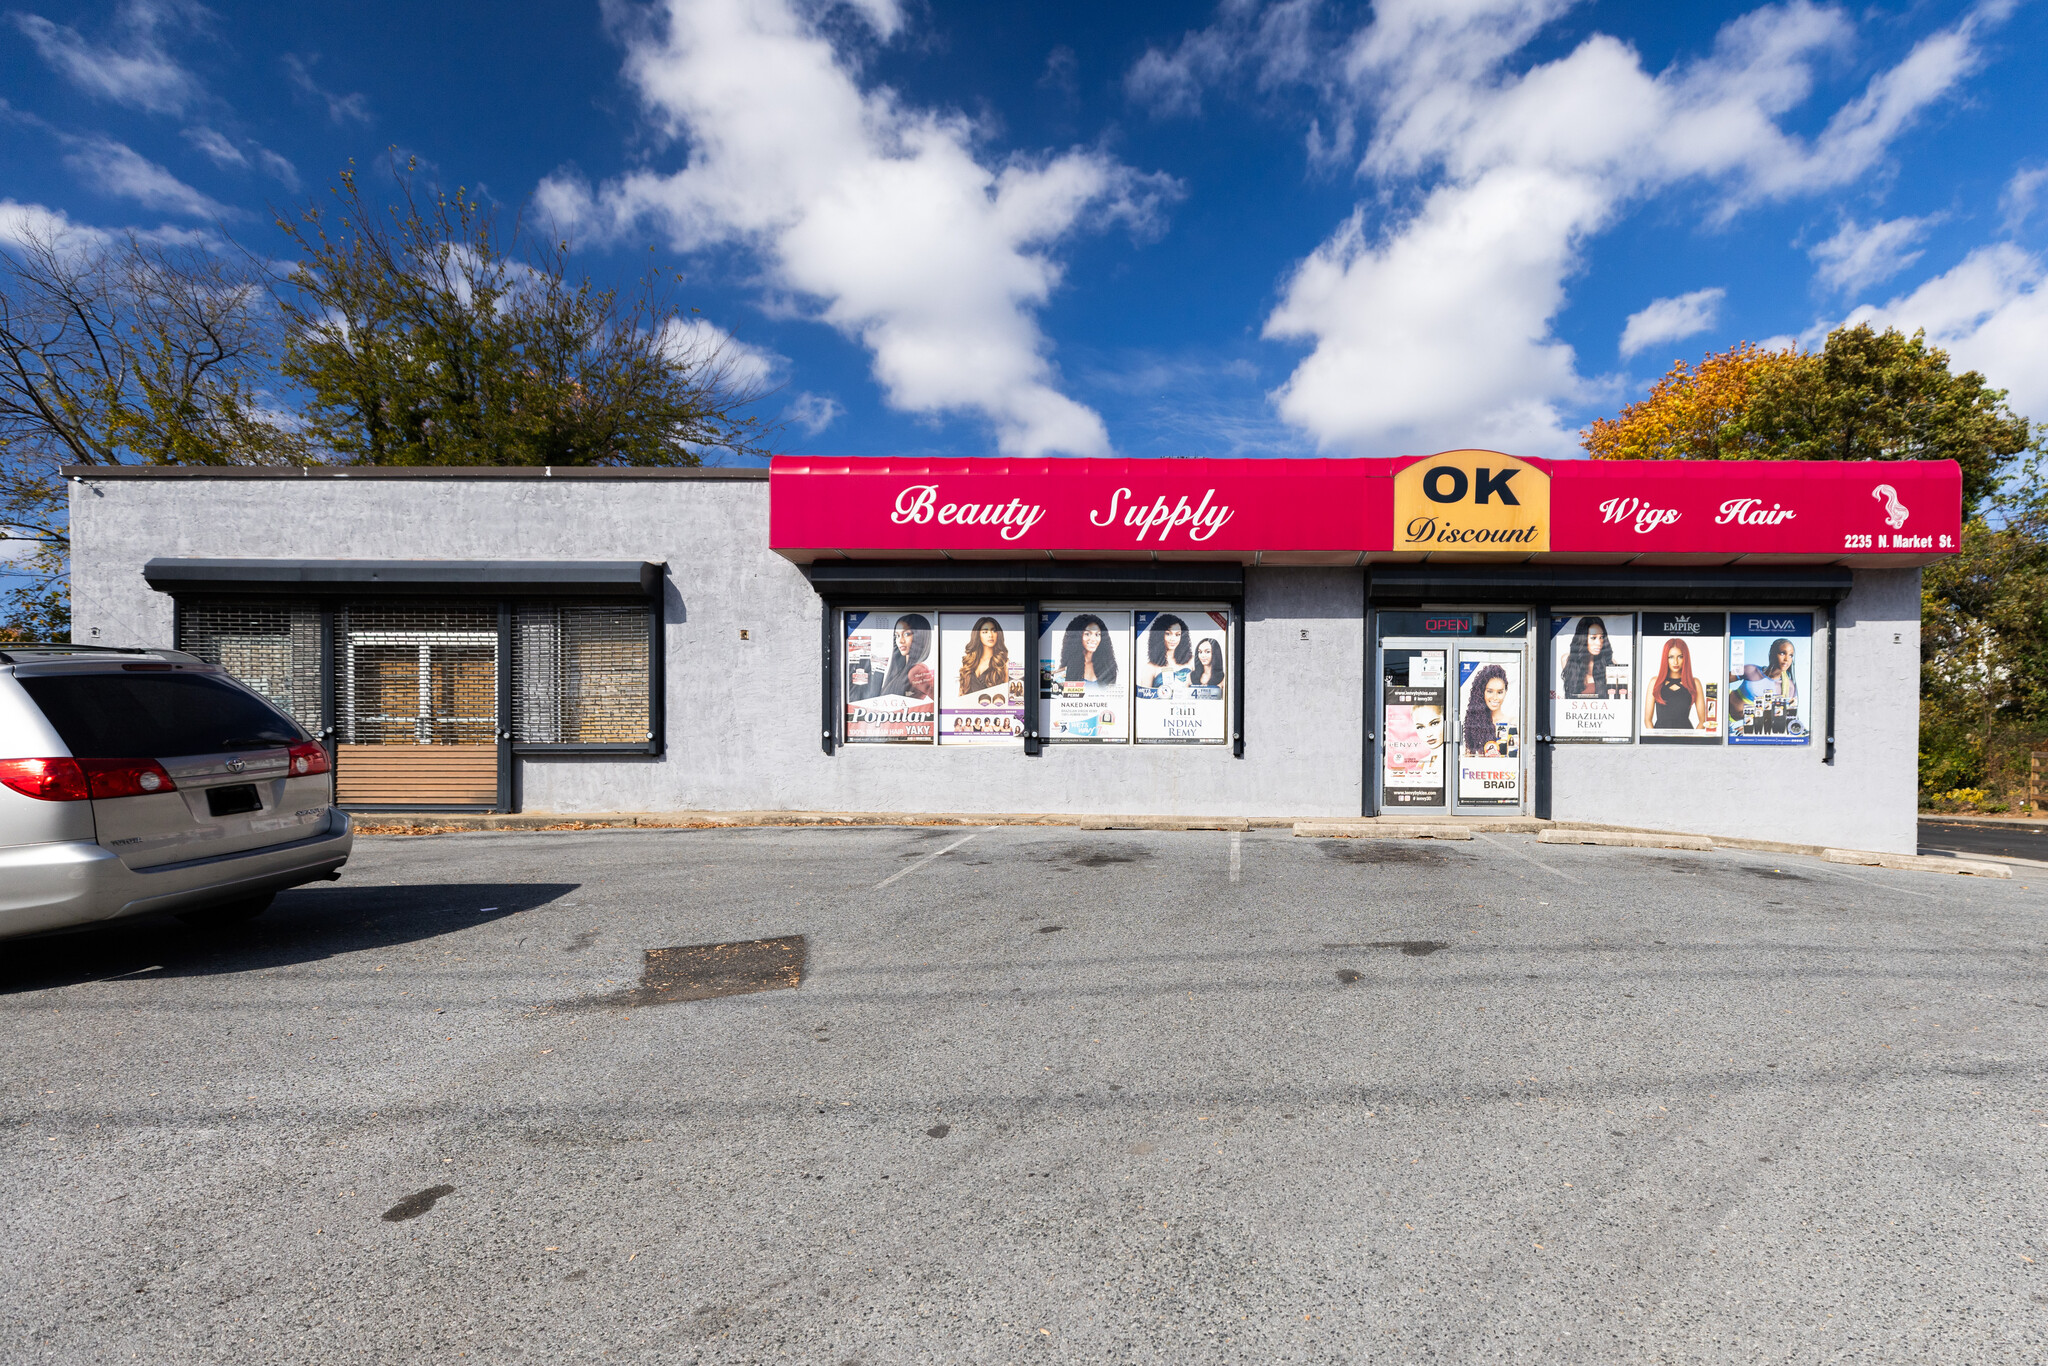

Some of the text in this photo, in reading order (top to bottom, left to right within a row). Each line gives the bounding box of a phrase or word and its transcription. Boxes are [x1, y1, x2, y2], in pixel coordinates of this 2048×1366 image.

[1422, 465, 1522, 506] OK
[890, 484, 1235, 542] Beauty Supply
[1598, 497, 1797, 534] Wigs Hair
[1404, 516, 1540, 543] Discount
[1844, 534, 1956, 549] 2235 N. Market St.
[1425, 619, 1469, 631] OPEN
[1748, 619, 1796, 629] RUWA
[1190, 688, 1198, 699] 4
[872, 699, 908, 707] SAGA
[1571, 701, 1609, 710] SAGA
[851, 706, 931, 727] Popular
[1565, 712, 1616, 721] BRAZILIAN
[1163, 718, 1203, 728] INDIAN
[1577, 720, 1604, 729] REMY
[905, 725, 931, 735] YAKY
[1168, 727, 1197, 737] REMY
[1483, 780, 1516, 789] BRAID
